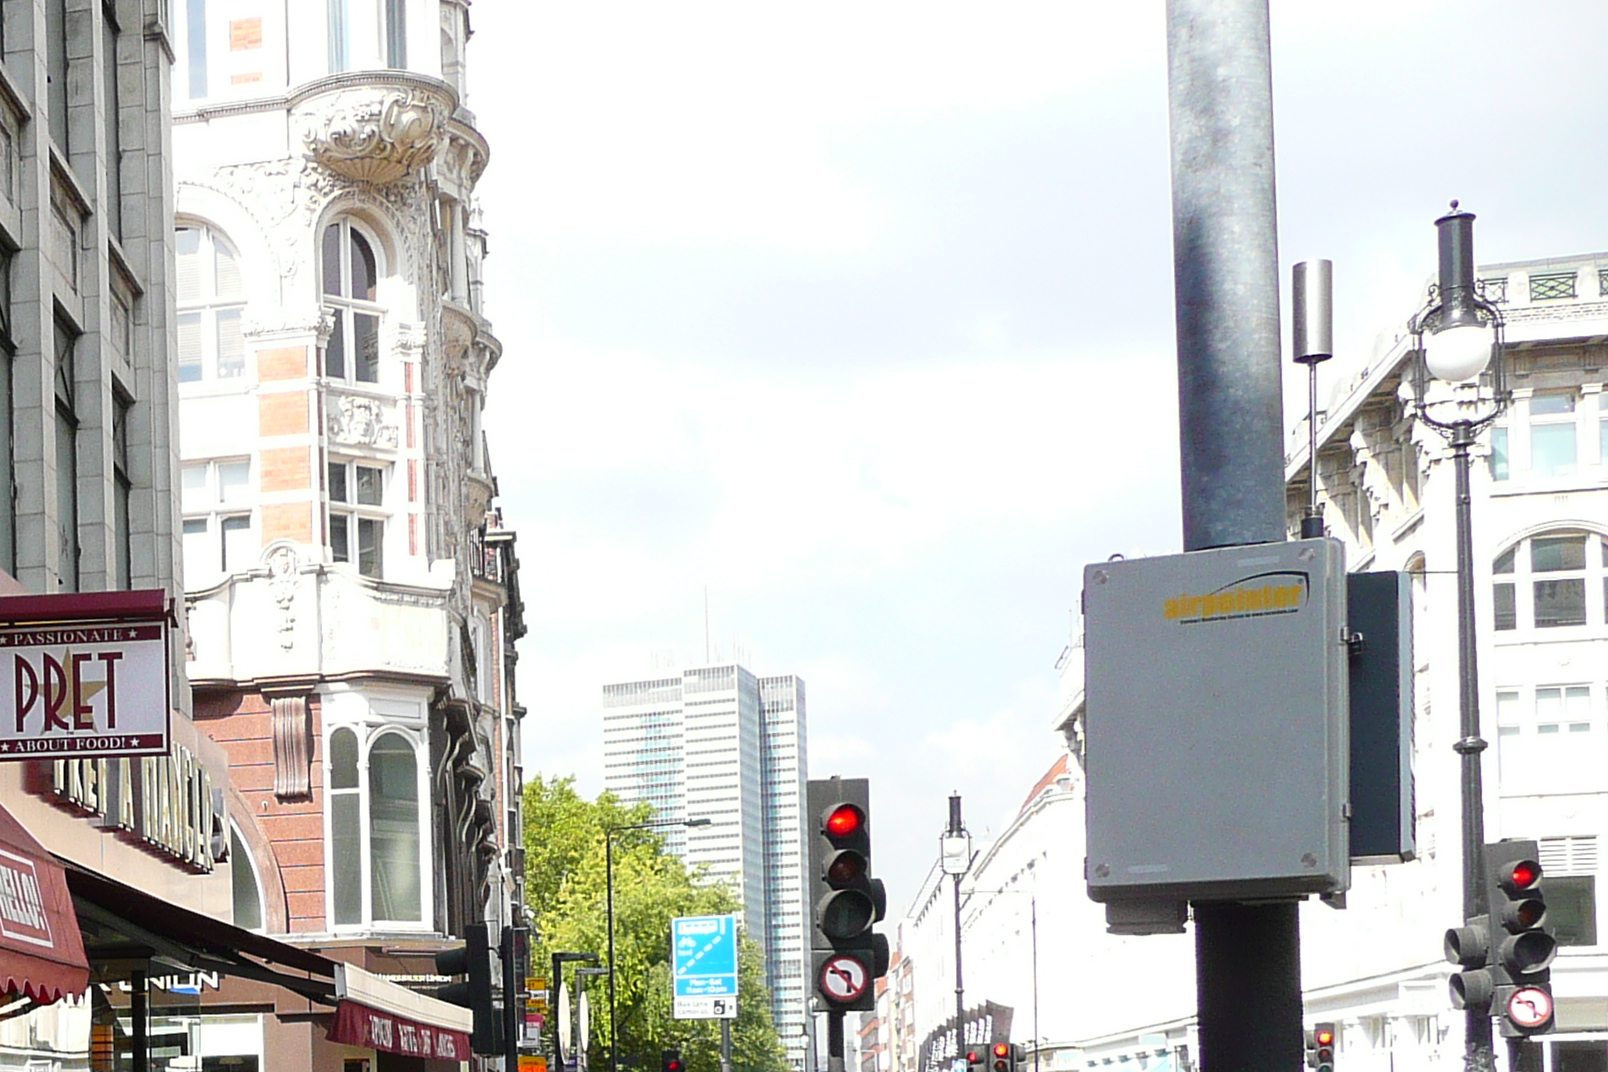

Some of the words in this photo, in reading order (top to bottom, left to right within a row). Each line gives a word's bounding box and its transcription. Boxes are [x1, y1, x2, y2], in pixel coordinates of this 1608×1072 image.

[13, 628, 123, 646] PASSIONATE
[14, 651, 123, 733] PRET
[14, 738, 70, 753] ABOUT
[75, 736, 126, 750] FOOD!
